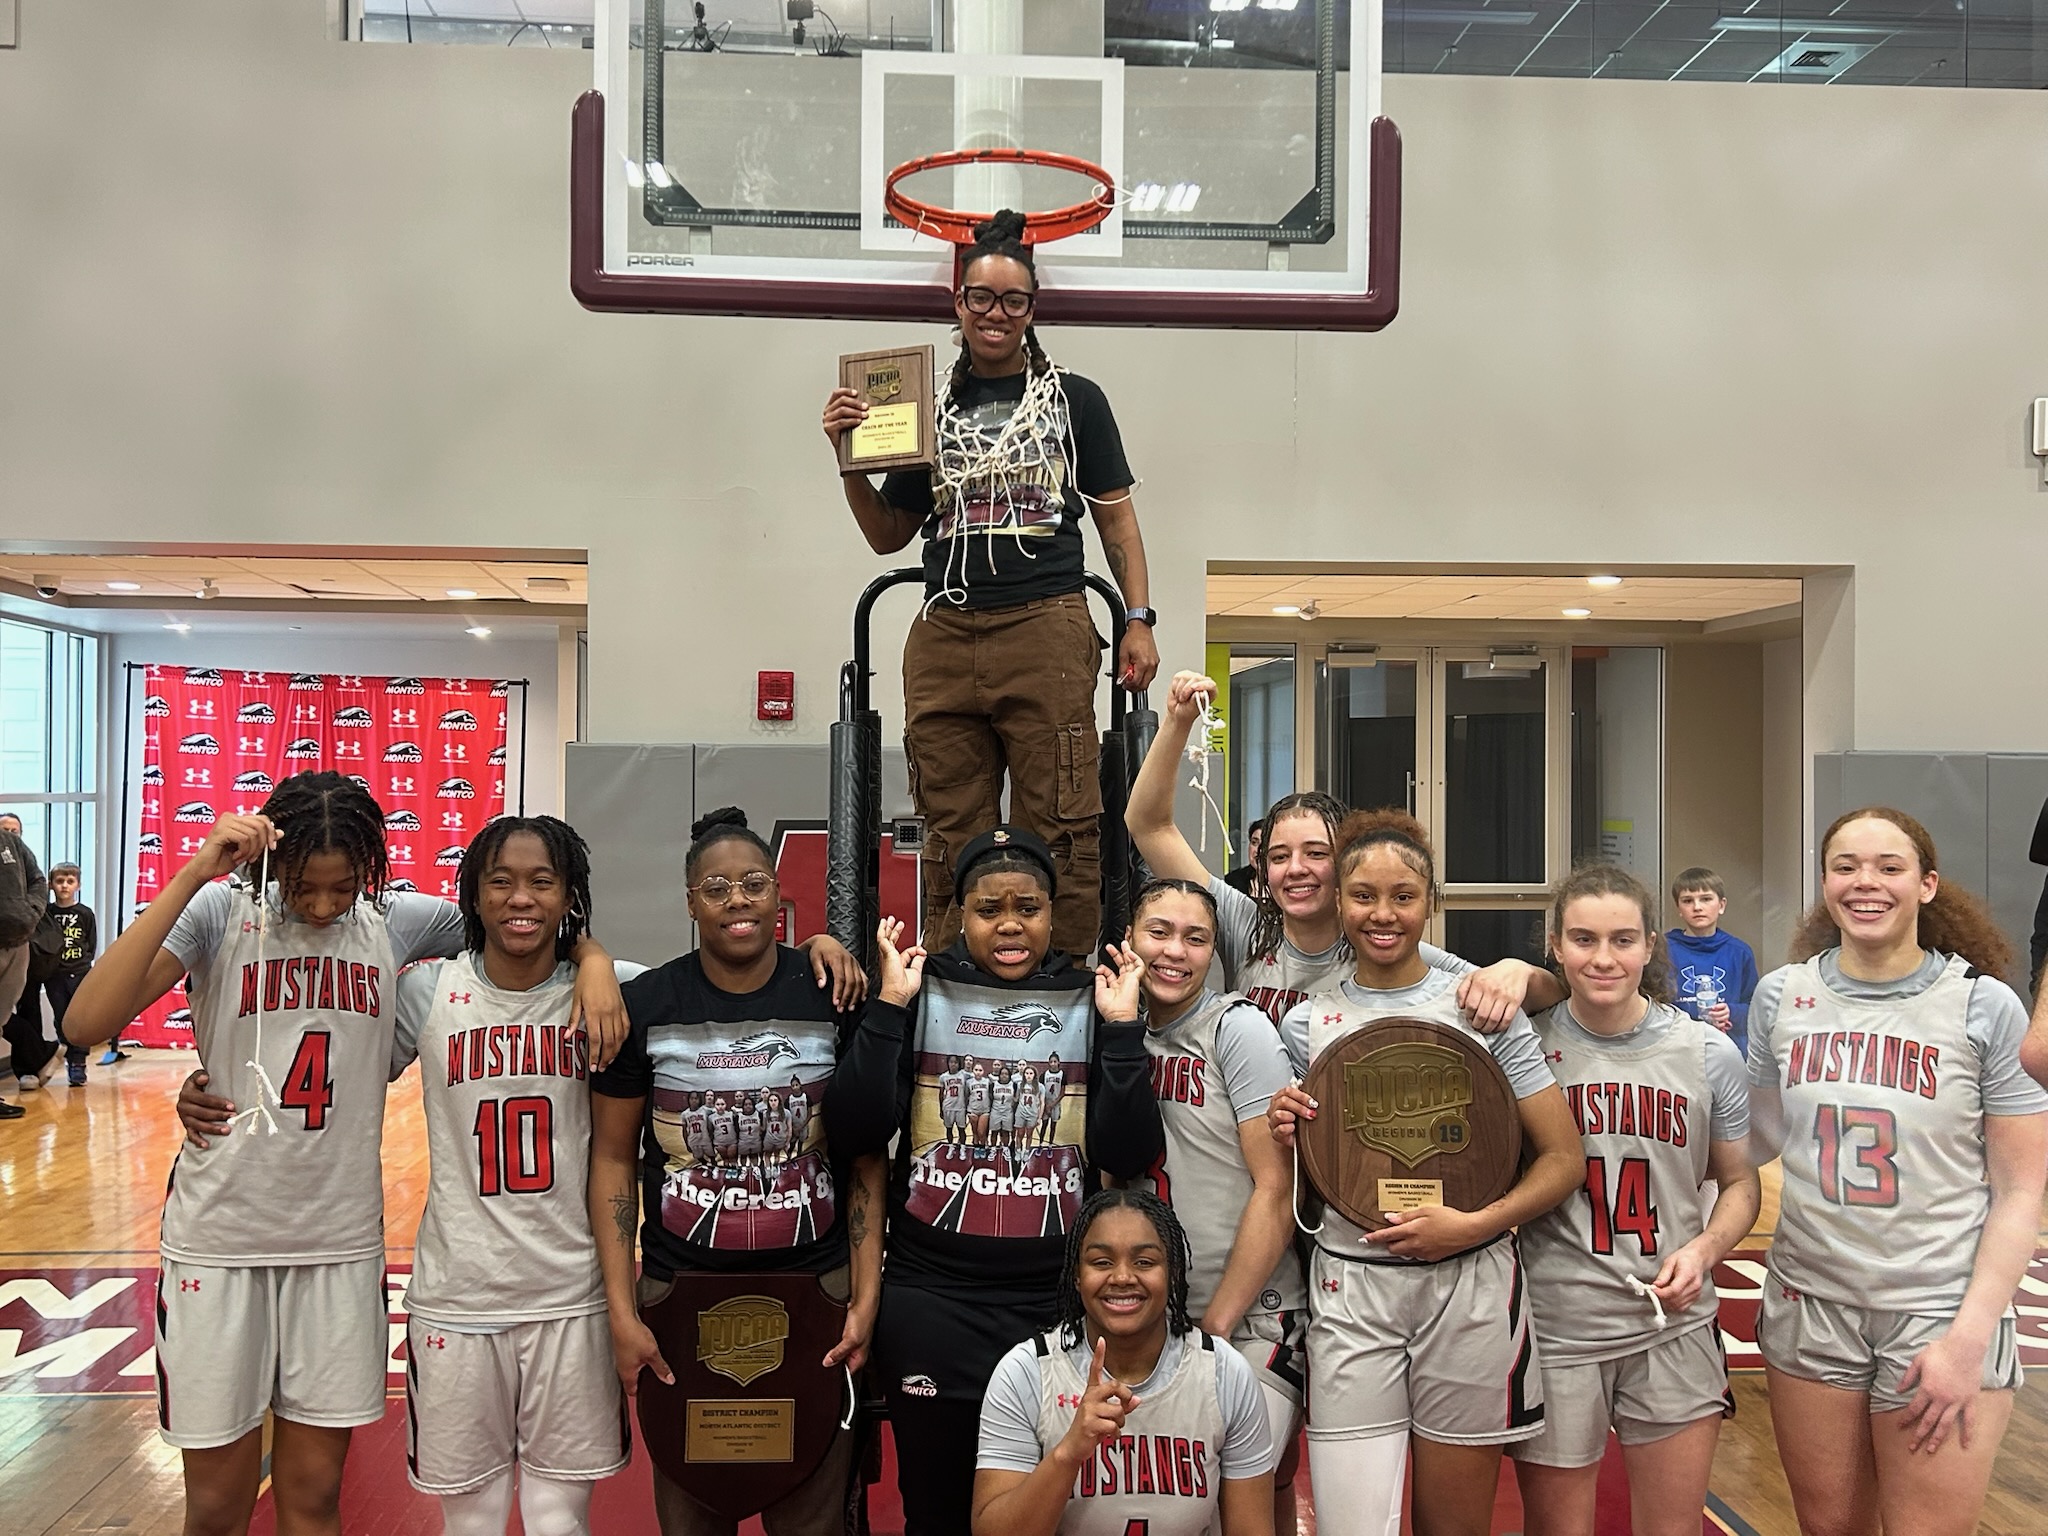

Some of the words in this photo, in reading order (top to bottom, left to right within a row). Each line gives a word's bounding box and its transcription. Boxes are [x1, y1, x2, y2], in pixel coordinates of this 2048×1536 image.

[183, 675, 224, 687] MONTCO
[288, 682, 324, 691] MONTCO
[385, 686, 425, 696] MONTCO
[236, 714, 276, 725] MONTCO
[333, 717, 373, 728] MONTCO
[438, 721, 478, 731] MONTCO
[178, 745, 220, 755] MONTCO
[383, 753, 423, 764] MONTCO
[232, 782, 273, 793] MONTCO
[437, 789, 475, 799] MONTCO
[174, 813, 216, 824] MONTCO
[435, 857, 461, 867] MONT
[238, 955, 381, 1019] MUSTANGS
[163, 1020, 193, 1030] MONT
[957, 1020, 1031, 1039] MUSTANGS
[447, 1025, 588, 1087] MUSTANGS
[697, 1055, 769, 1068] MUSTANGS
[1786, 1031, 1940, 1100] MUSTANGS
[281, 1031, 333, 1131] 4
[1149, 1055, 1207, 1108] ANGS
[1347, 1064, 1472, 1127] NJCAA
[1563, 1082, 1687, 1148] USTANGS
[1372, 1126, 1426, 1138] REGION
[1438, 1124, 1463, 1143] 19
[473, 1096, 555, 1197] 10
[1812, 1104, 1899, 1208] 13
[911, 1156, 964, 1191] The
[971, 1166, 1061, 1196] Great
[1065, 1167, 1081, 1193] 8
[667, 1172, 715, 1208] The
[724, 1175, 812, 1211] Great
[815, 1171, 829, 1200] 8
[1583, 1156, 1659, 1256] 14
[699, 1314, 788, 1357] NJCAA
[902, 1384, 937, 1397] MONTCO
[702, 1409, 738, 1417] DISTRICT
[740, 1409, 779, 1417] CHAMPION
[1069, 1434, 1208, 1499] USTANGS
